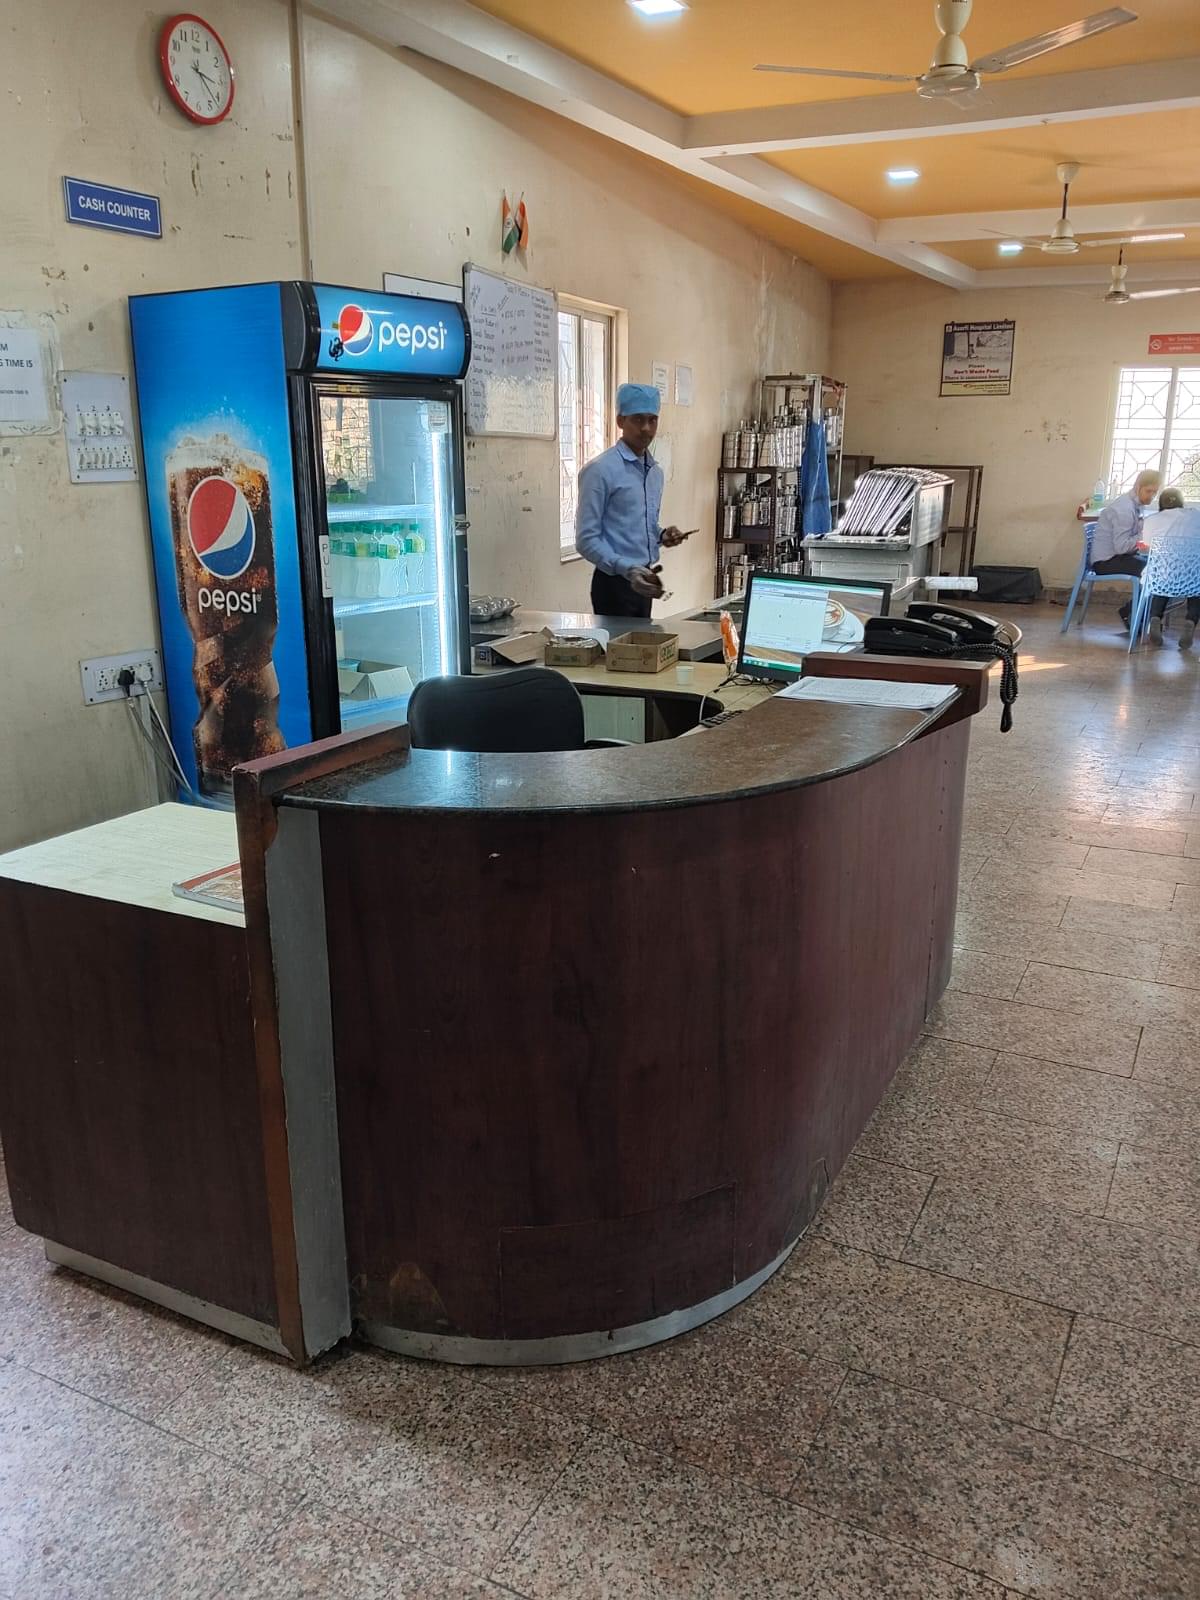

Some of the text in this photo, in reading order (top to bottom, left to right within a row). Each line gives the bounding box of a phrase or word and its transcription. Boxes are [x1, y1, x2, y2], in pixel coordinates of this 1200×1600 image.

[180, 29, 187, 42] 11
[192, 29, 200, 43] 12
[205, 40, 209, 52] 1
[213, 56, 219, 68] 2
[184, 90, 190, 102] 7
[207, 99, 213, 111] 5
[78, 195, 151, 222] CASH COUNTER
[378, 320, 446, 356] pepsi
[5, 358, 25, 368] TIME
[26, 359, 33, 368] IS
[322, 543, 332, 590] PULL
[198, 587, 257, 617] pepsi
